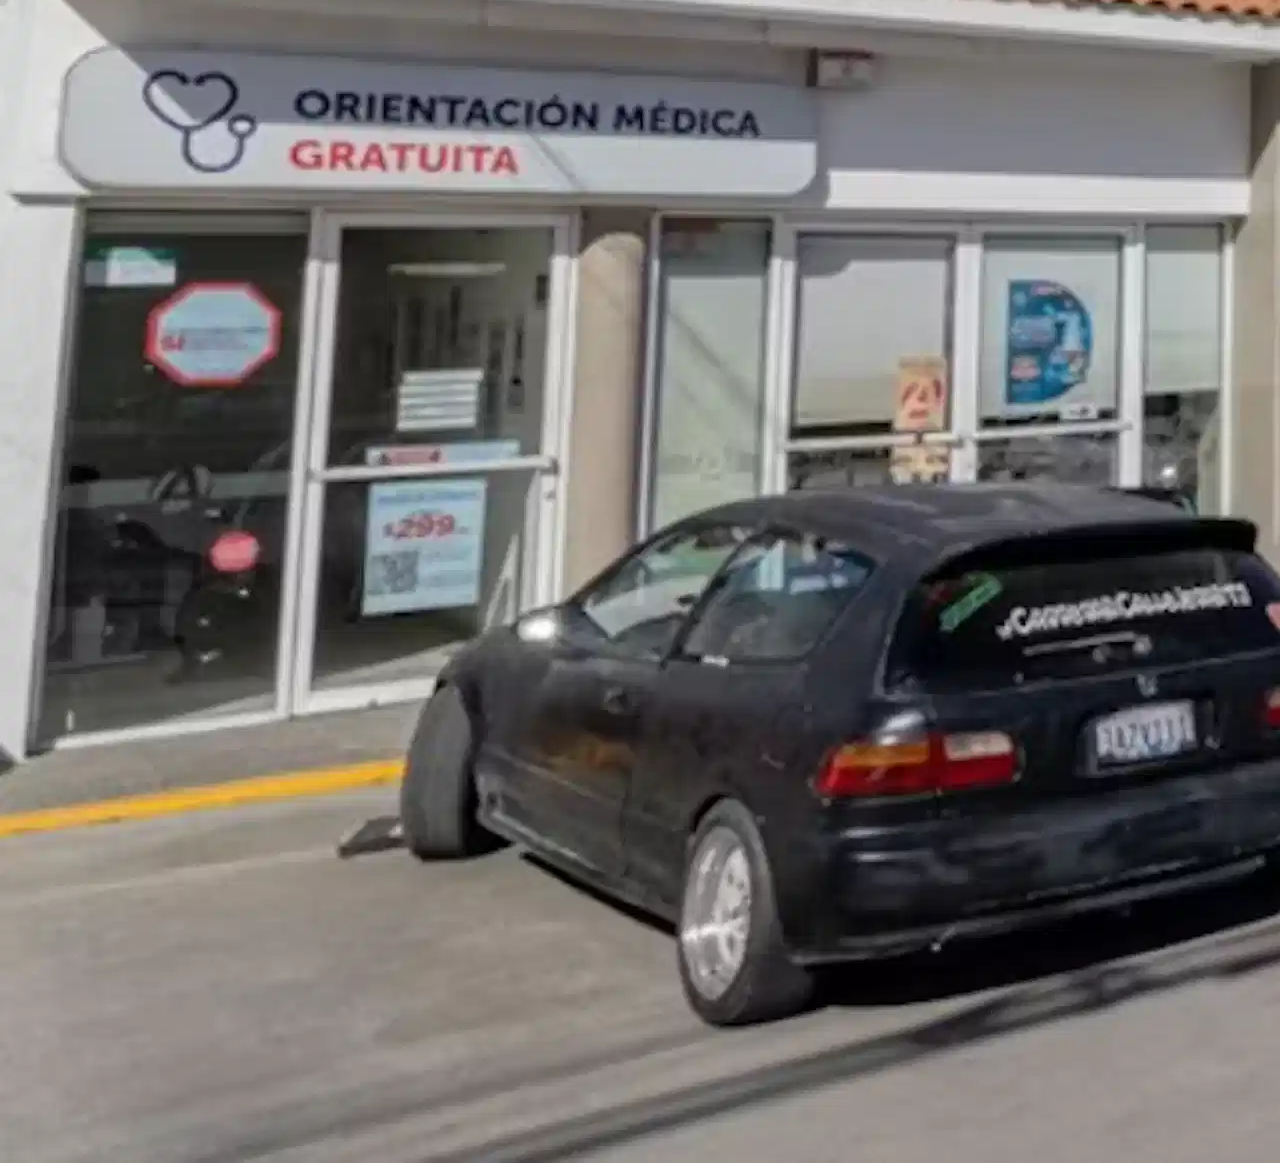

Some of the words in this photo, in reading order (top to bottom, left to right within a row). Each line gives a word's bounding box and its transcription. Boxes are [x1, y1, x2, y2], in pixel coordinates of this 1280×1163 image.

[294, 89, 600, 131] ORIENTACIÓN
[613, 99, 760, 138] MÉDICA
[289, 139, 520, 176] GRATUITA
